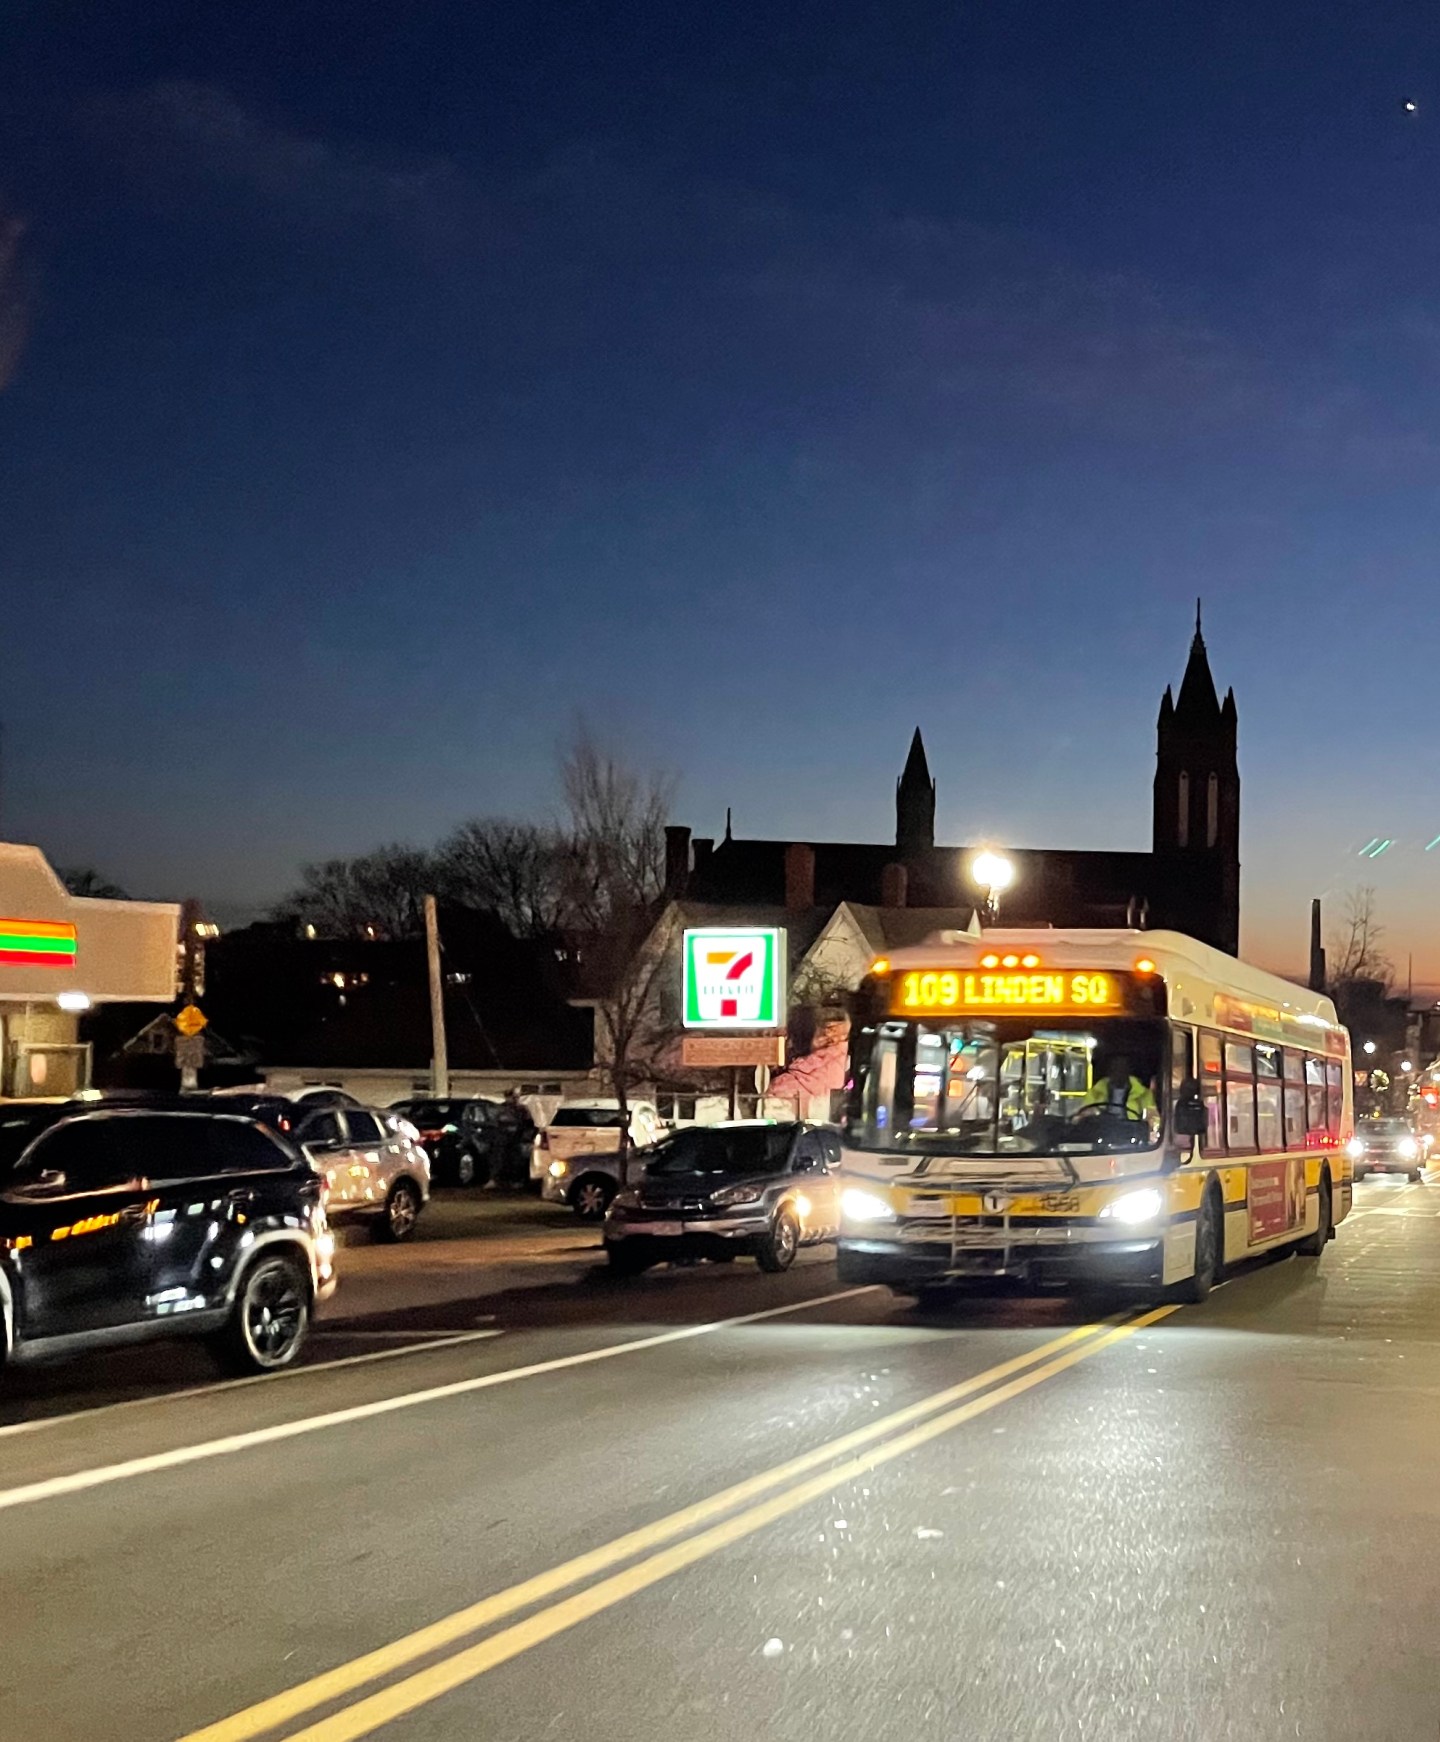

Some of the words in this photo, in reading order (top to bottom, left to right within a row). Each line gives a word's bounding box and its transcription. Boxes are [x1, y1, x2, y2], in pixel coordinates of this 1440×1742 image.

[706, 951, 753, 981] 7
[904, 973, 959, 1006] 109
[964, 975, 1064, 1004] LINDEN
[1071, 975, 1108, 1004] SQ
